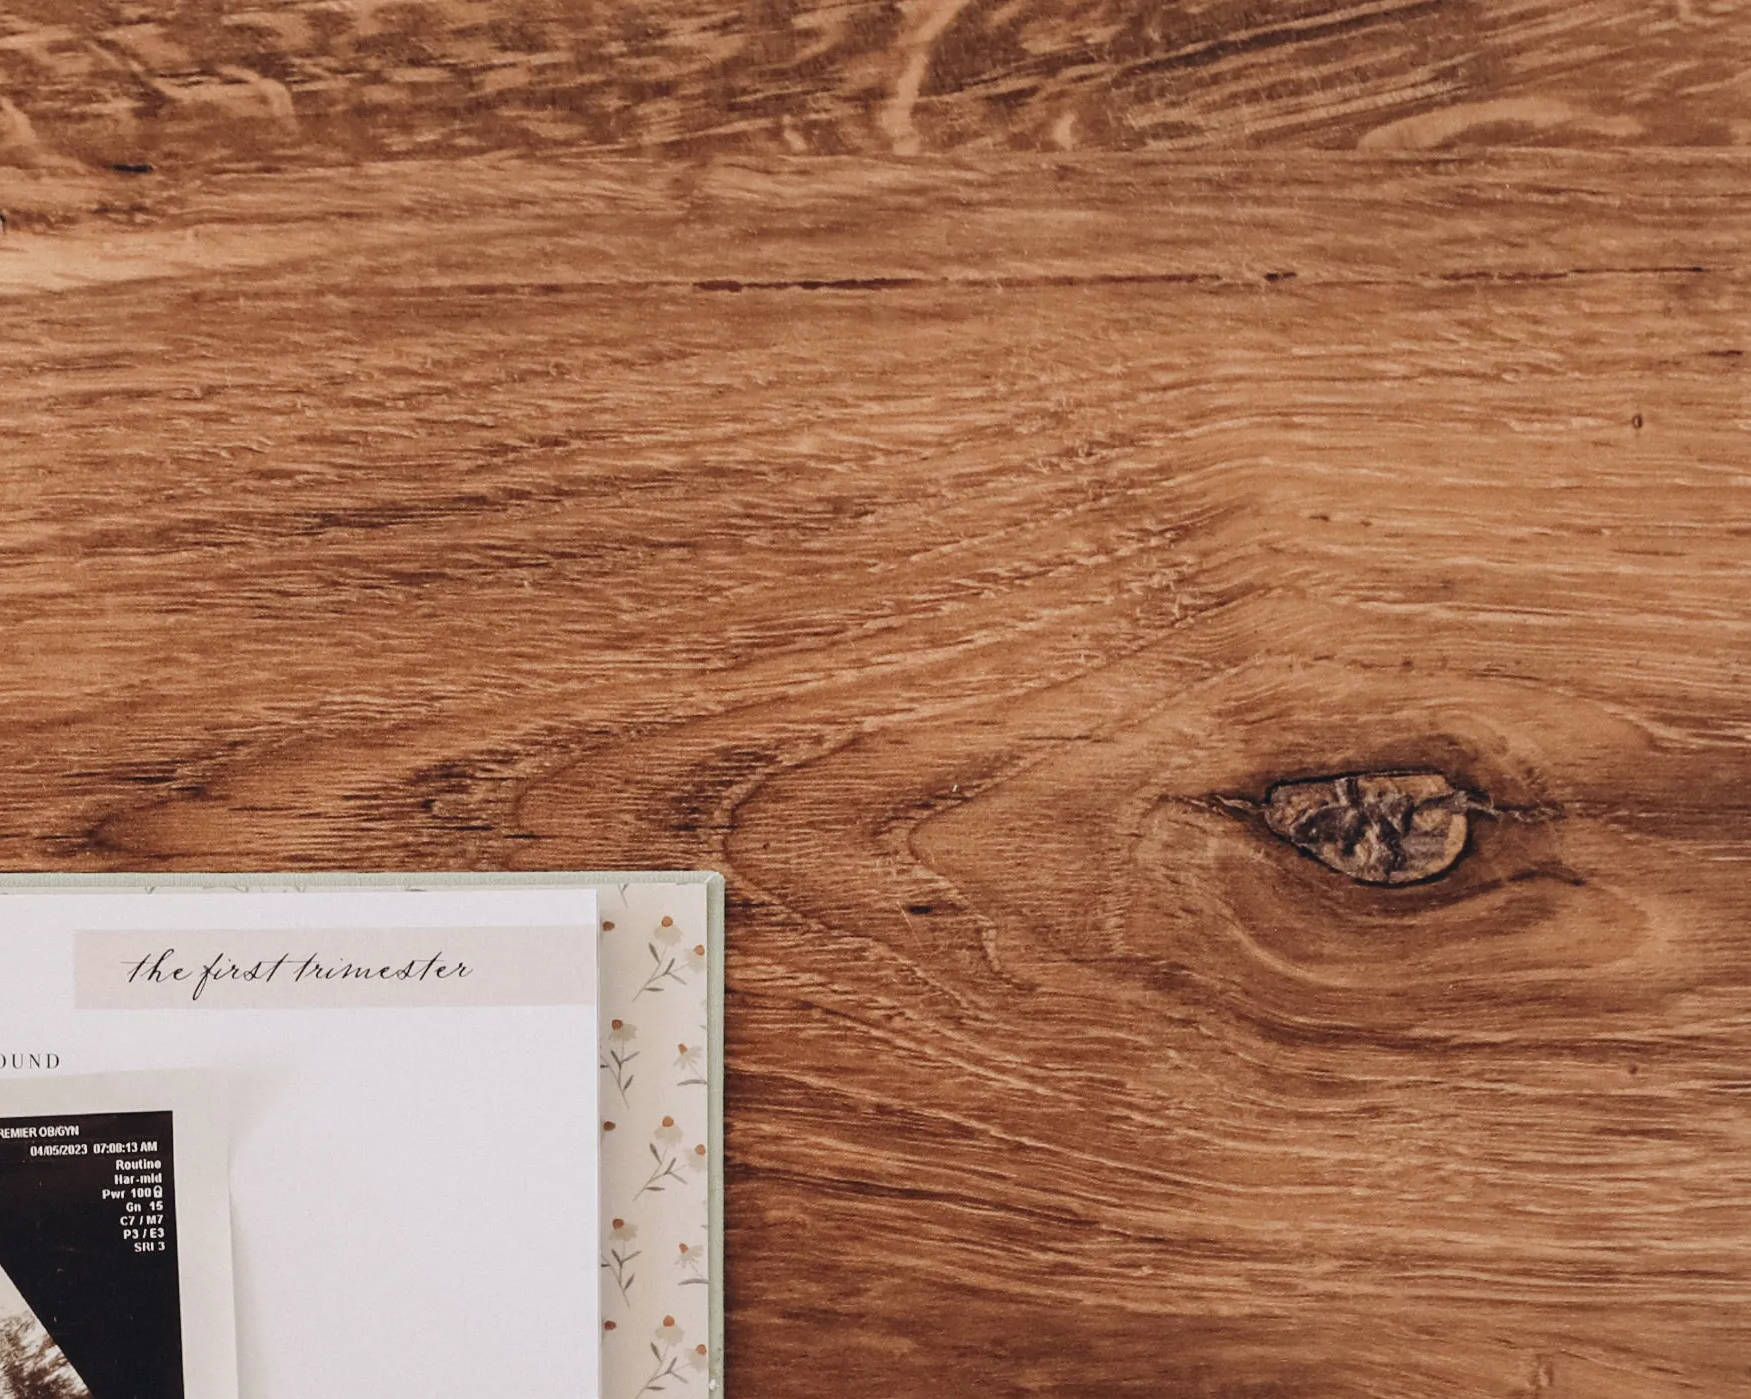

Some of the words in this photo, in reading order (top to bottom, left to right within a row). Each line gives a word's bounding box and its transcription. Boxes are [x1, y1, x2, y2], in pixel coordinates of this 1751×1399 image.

[122, 948, 192, 983] the
[192, 953, 290, 1001] first
[294, 951, 475, 983] trimester
[38, 1125, 80, 1138] OB/GYN
[30, 1144, 89, 1158] 04/05/2023
[139, 1141, 159, 1153] AM
[115, 1158, 162, 1171] Routine
[101, 1188, 126, 1200] Pwr
[130, 1187, 152, 1199] 100
[125, 1201, 142, 1213] Gn
[149, 1200, 164, 1212] 15
[119, 1215, 135, 1227] C7
[146, 1214, 164, 1225] M7
[123, 1228, 139, 1240] P3
[149, 1227, 165, 1239] E3
[133, 1241, 155, 1253] SRI
[157, 1241, 166, 1252] 3
